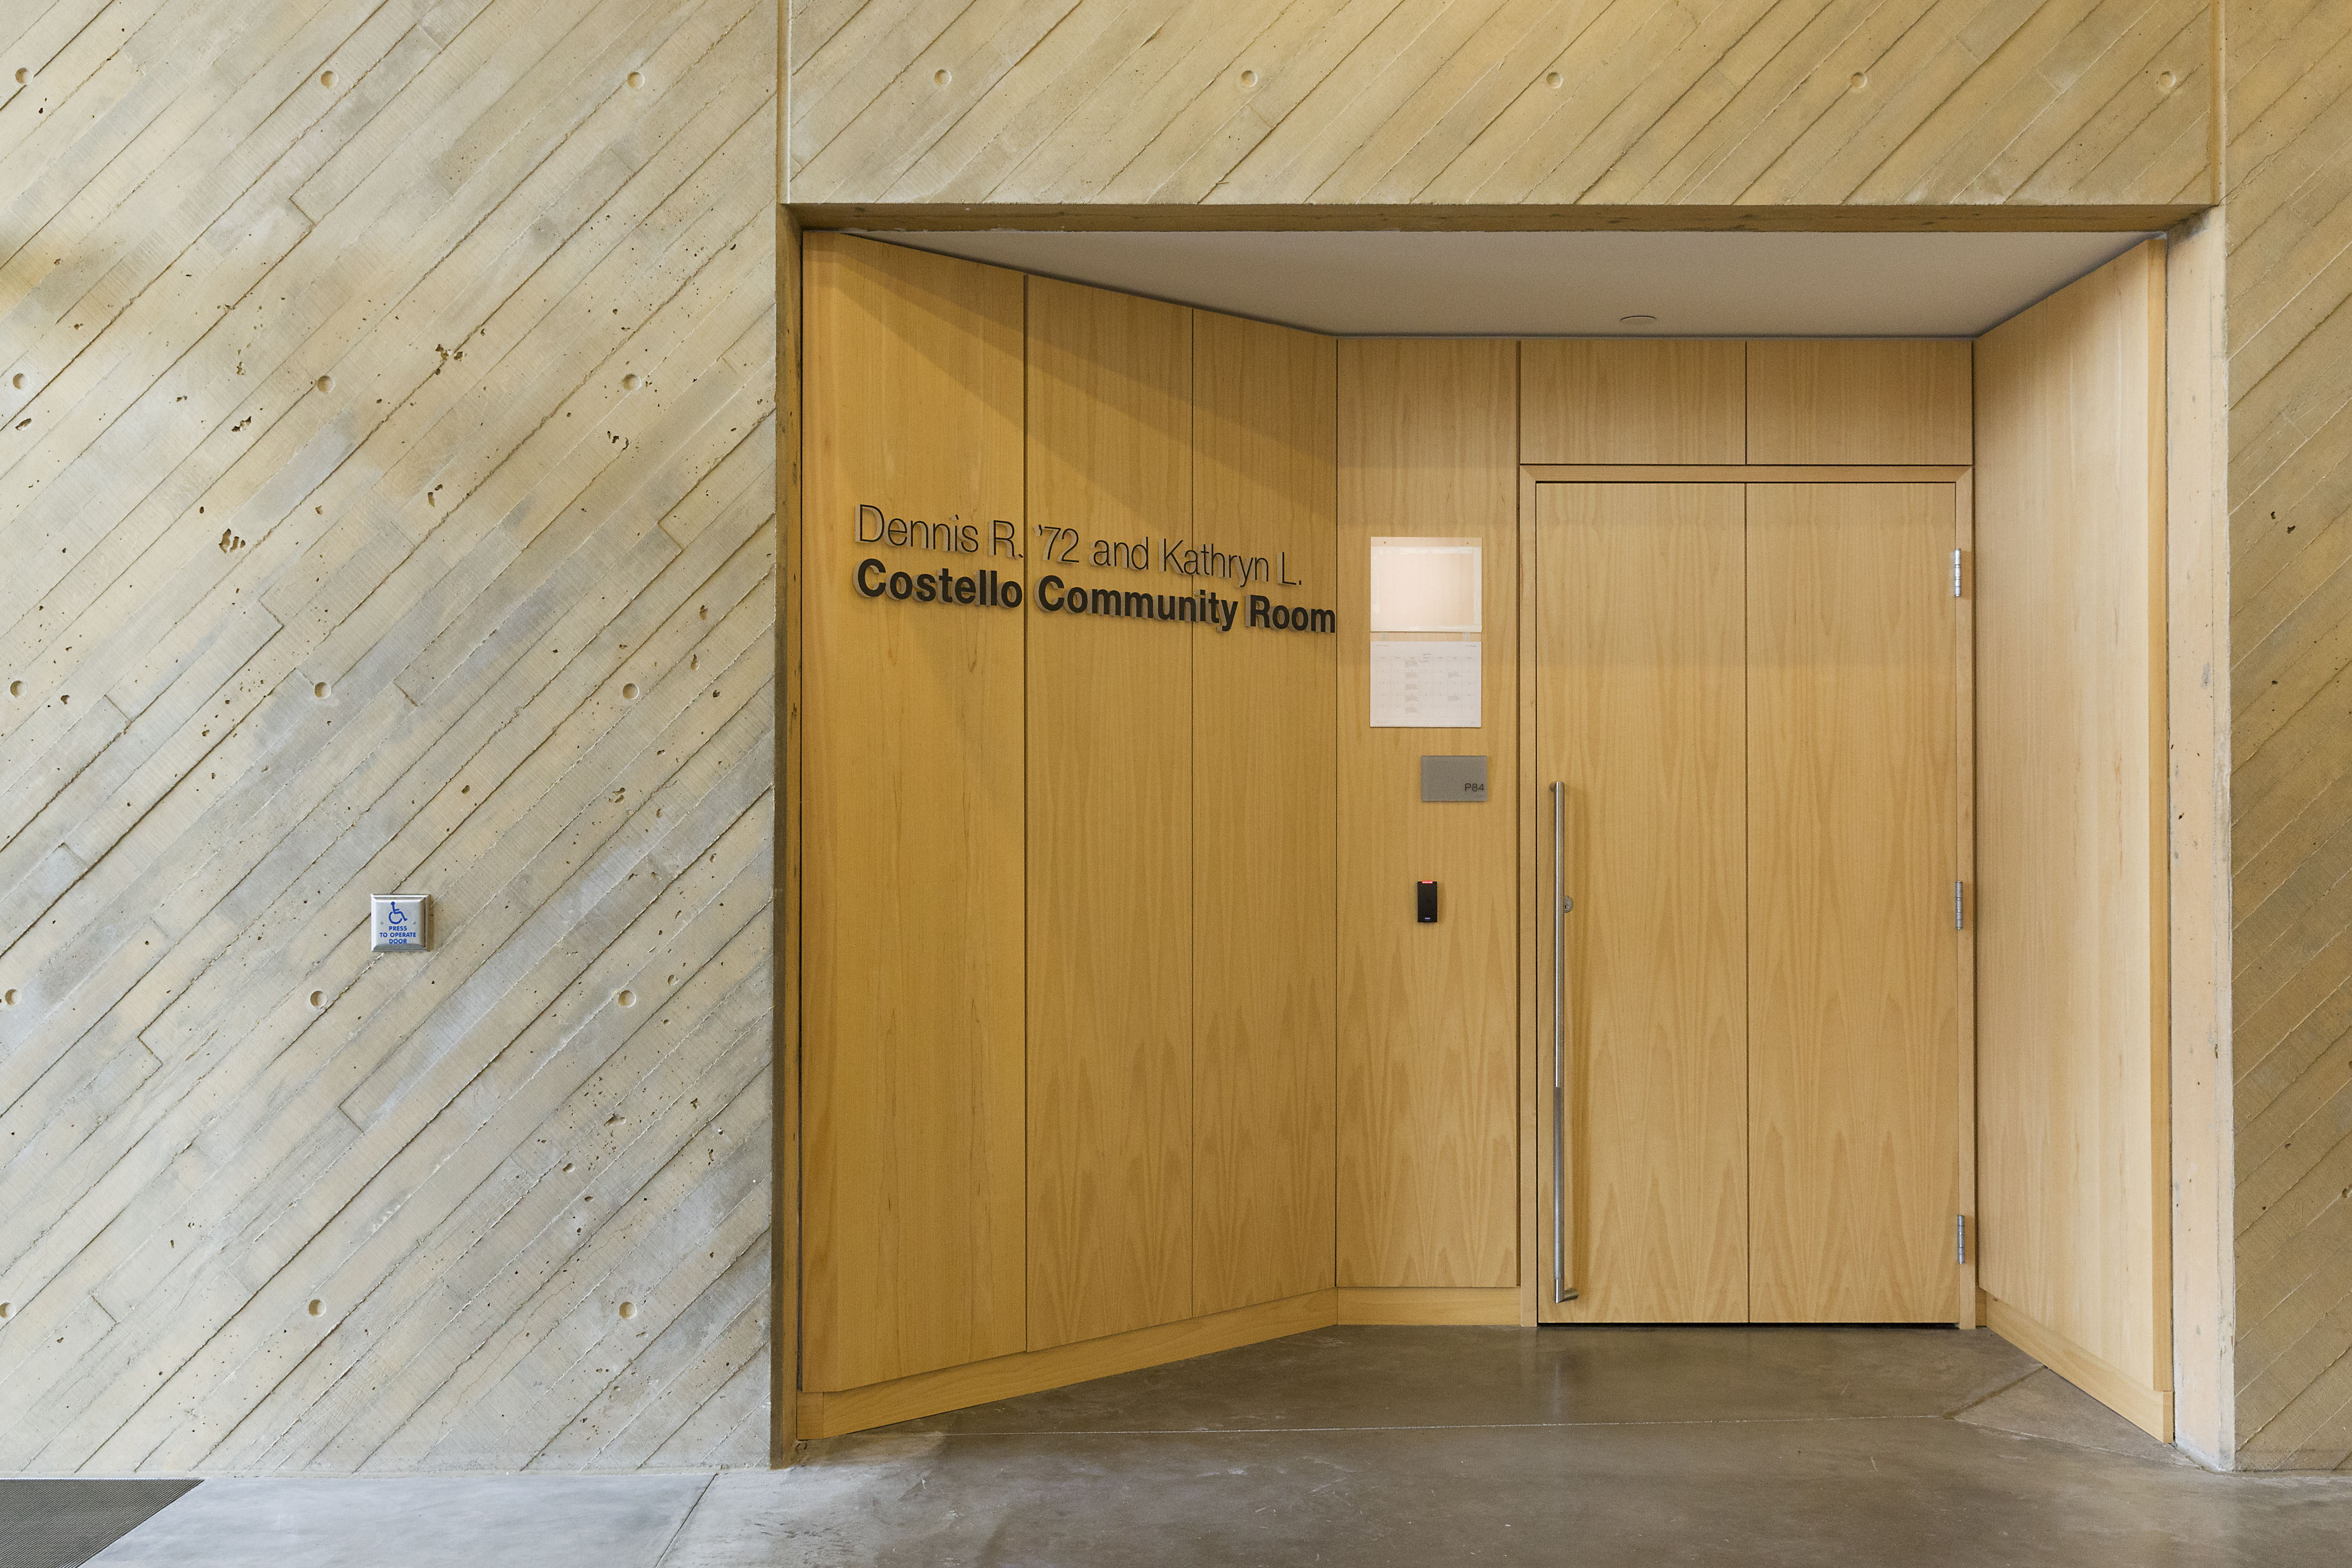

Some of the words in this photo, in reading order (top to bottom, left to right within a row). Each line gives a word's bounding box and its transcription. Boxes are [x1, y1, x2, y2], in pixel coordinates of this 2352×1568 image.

[859, 504, 978, 553] Dennis
[993, 519, 1024, 559] R.
[1093, 536, 1149, 570] and
[1163, 538, 1269, 588] Kathryn
[1282, 552, 1302, 586] L.
[857, 557, 1023, 609] Costello
[1038, 574, 1239, 632] Community
[1250, 594, 1335, 634] Room
[1465, 783, 1485, 791] P84
